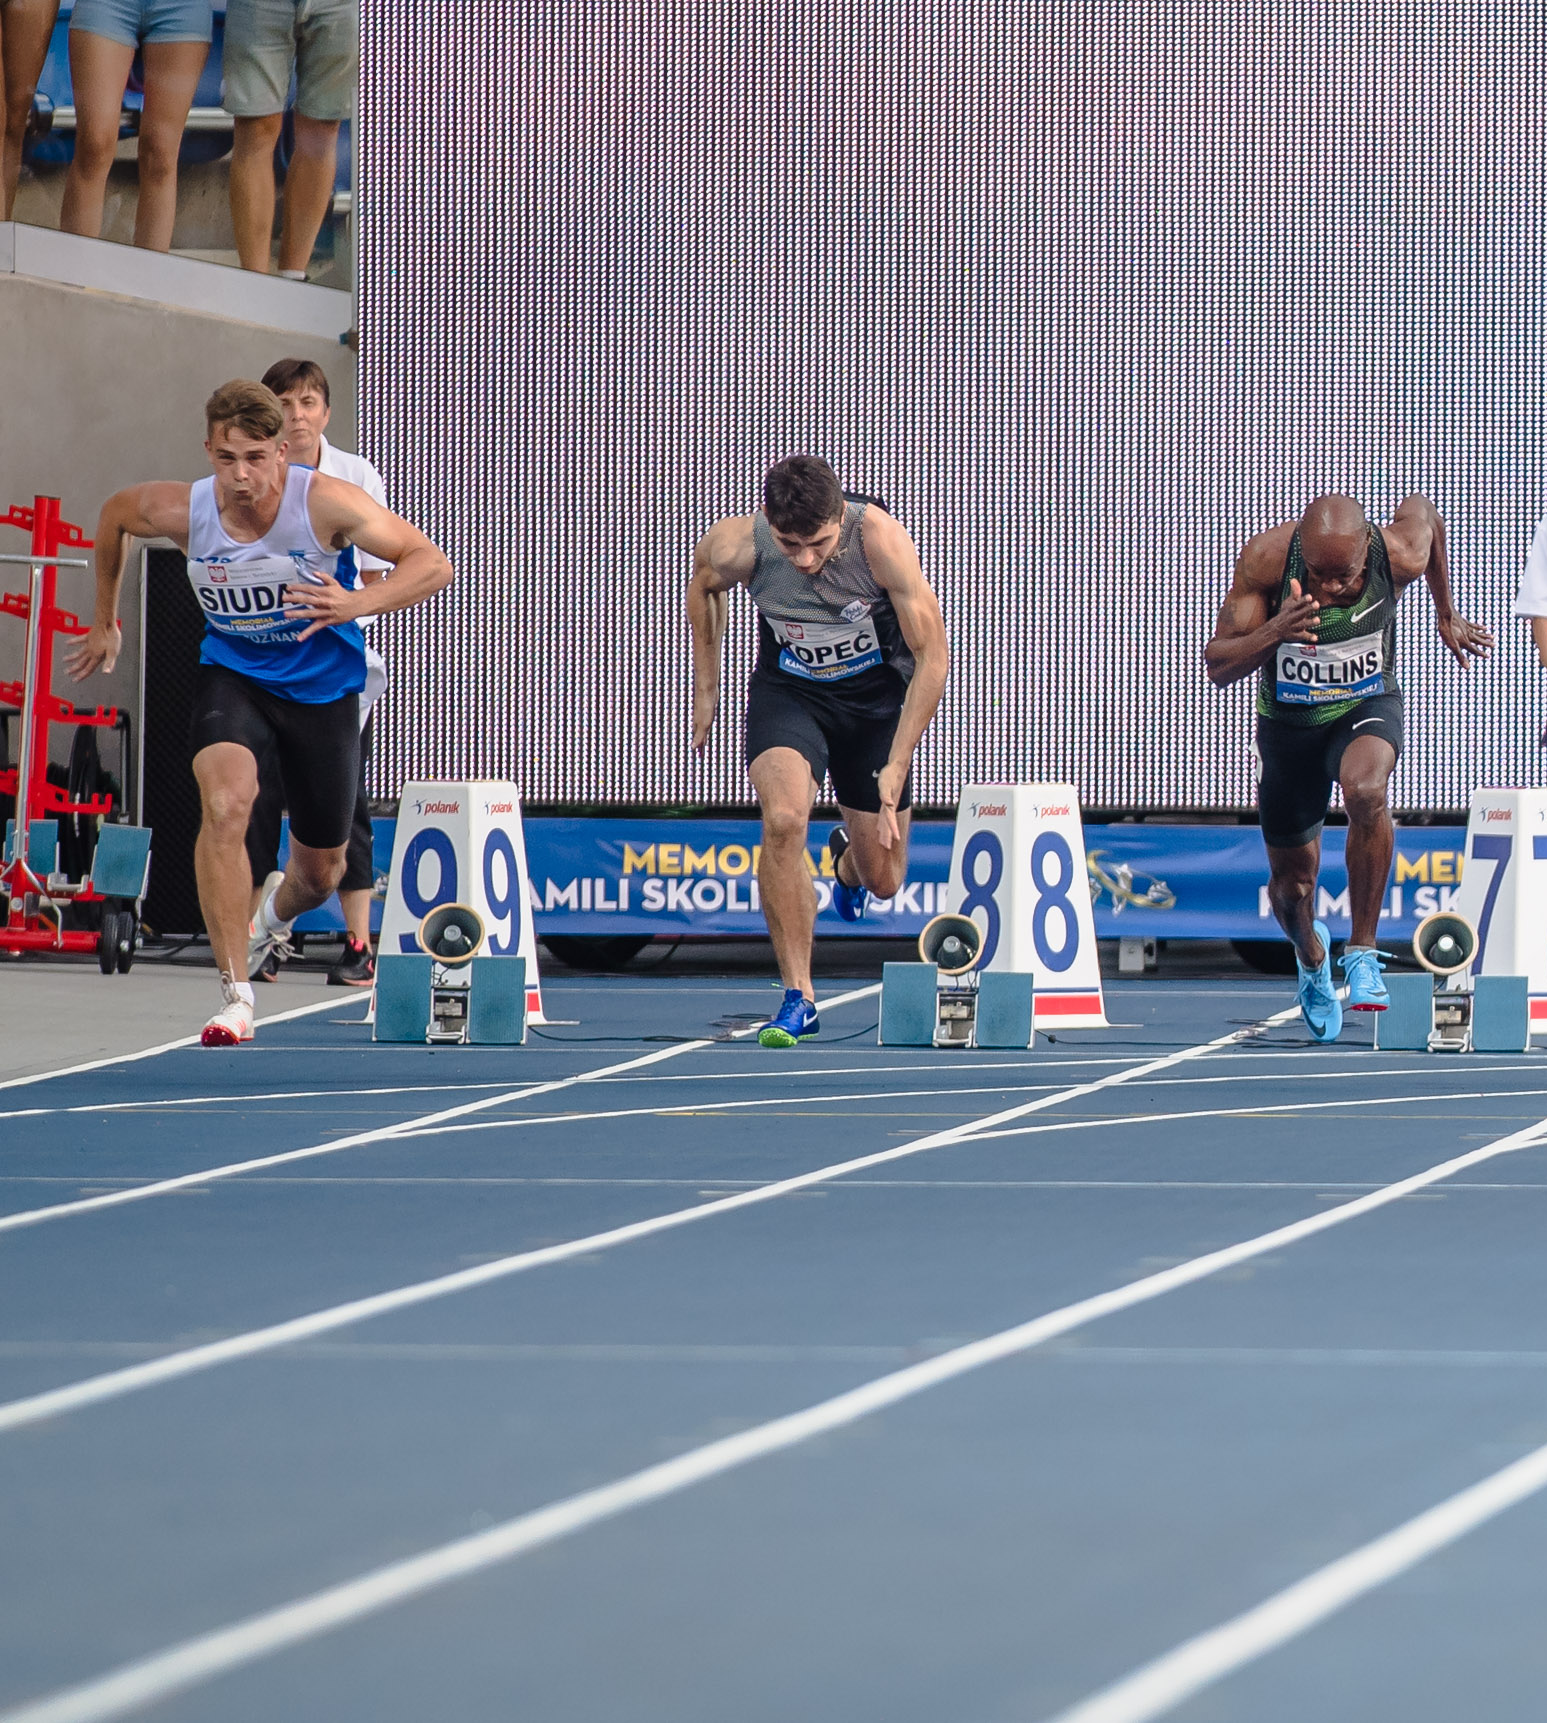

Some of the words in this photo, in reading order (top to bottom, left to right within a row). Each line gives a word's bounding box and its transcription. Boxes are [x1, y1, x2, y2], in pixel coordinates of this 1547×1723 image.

[199, 583, 298, 613] SIUDA
[780, 630, 873, 664] OPEĆ
[1282, 650, 1379, 684] COLLINS
[424, 801, 460, 816] polanik
[490, 801, 513, 816] polanik
[978, 803, 1007, 818] polanik
[1041, 803, 1070, 819] polanik
[1487, 808, 1513, 823] polanik
[401, 827, 458, 953] 9
[483, 827, 521, 957] 9
[528, 877, 630, 913] AMILI
[958, 829, 1003, 973] 8
[1031, 830, 1079, 973] 8
[1471, 834, 1513, 976] 7
